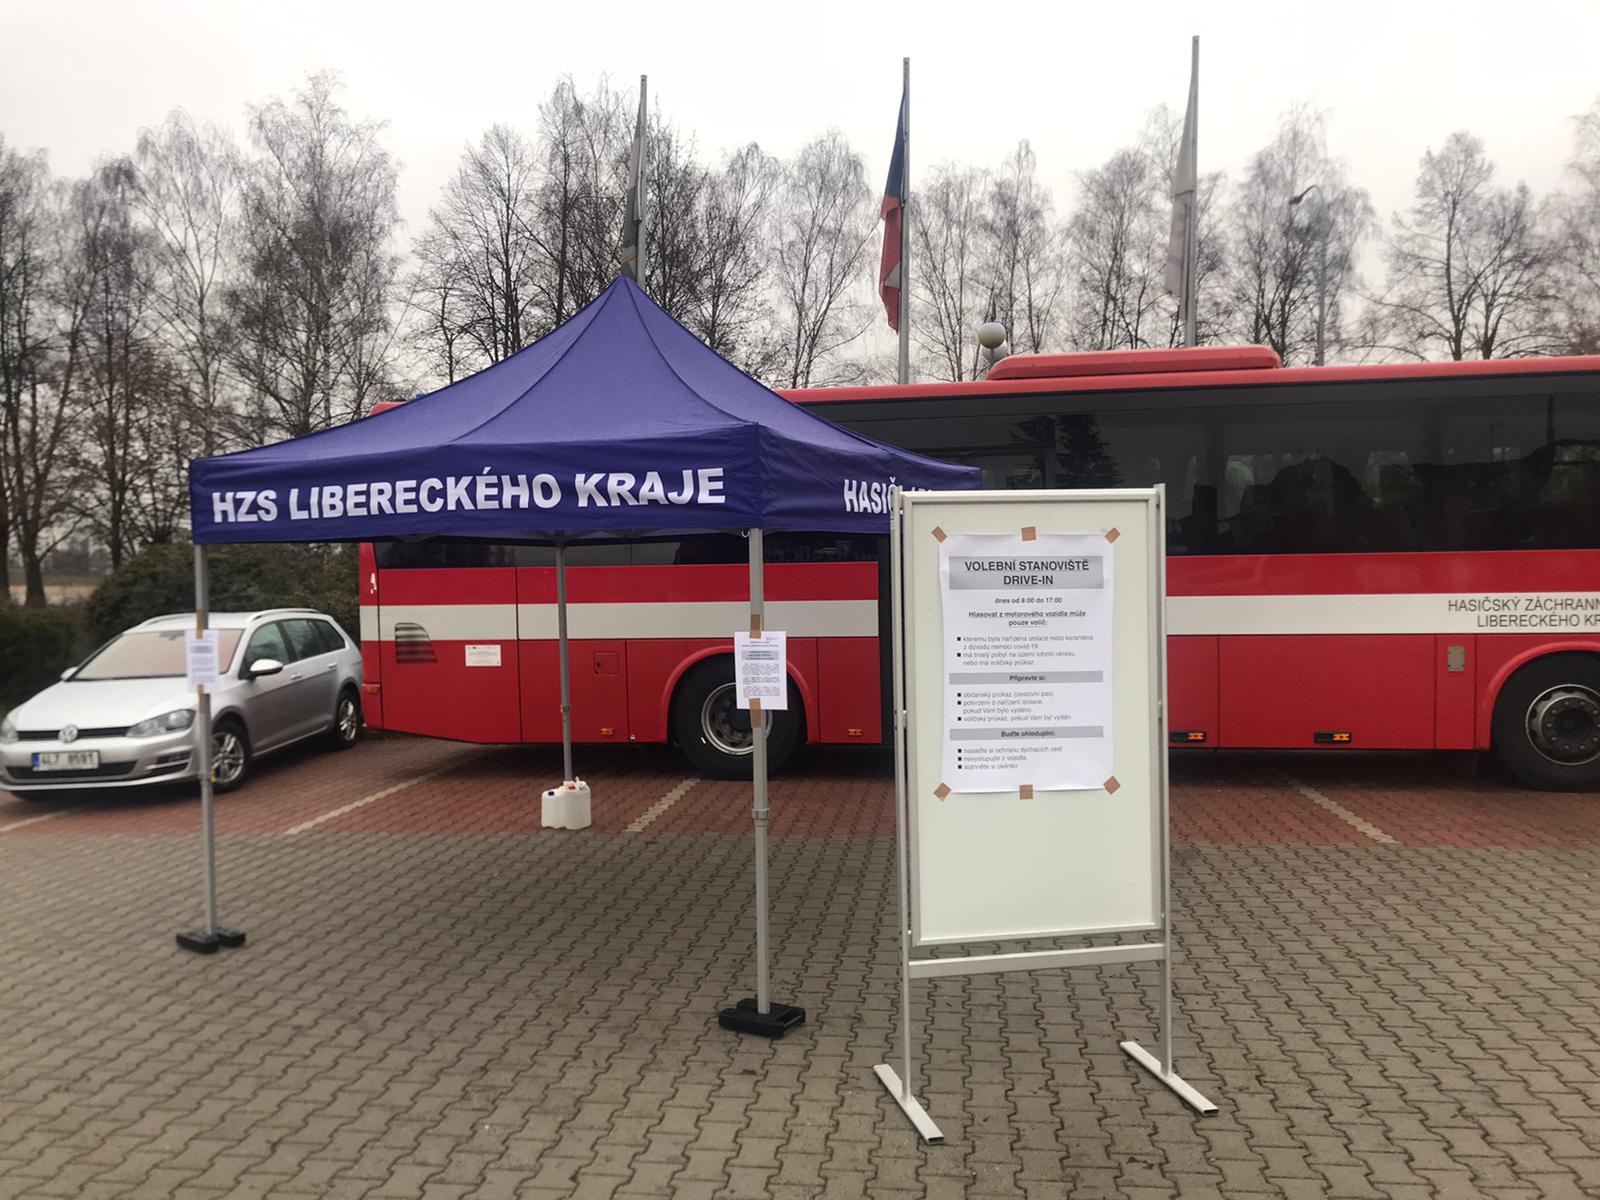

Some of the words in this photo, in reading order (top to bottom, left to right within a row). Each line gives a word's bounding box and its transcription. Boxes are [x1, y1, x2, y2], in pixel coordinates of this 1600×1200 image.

[212, 490, 278, 523] HZS
[289, 467, 562, 520] LIBERECKÉHO
[574, 467, 726, 508] KRAJE
[965, 560, 1015, 571] VOLEBNÍ
[1019, 560, 1089, 571] STANOVIŠTĚ
[1003, 575, 1053, 585] DRIVE-IN
[1448, 596, 1521, 612] HASIČSKÝ
[1477, 612, 1580, 627] LIBERECKÉHO
